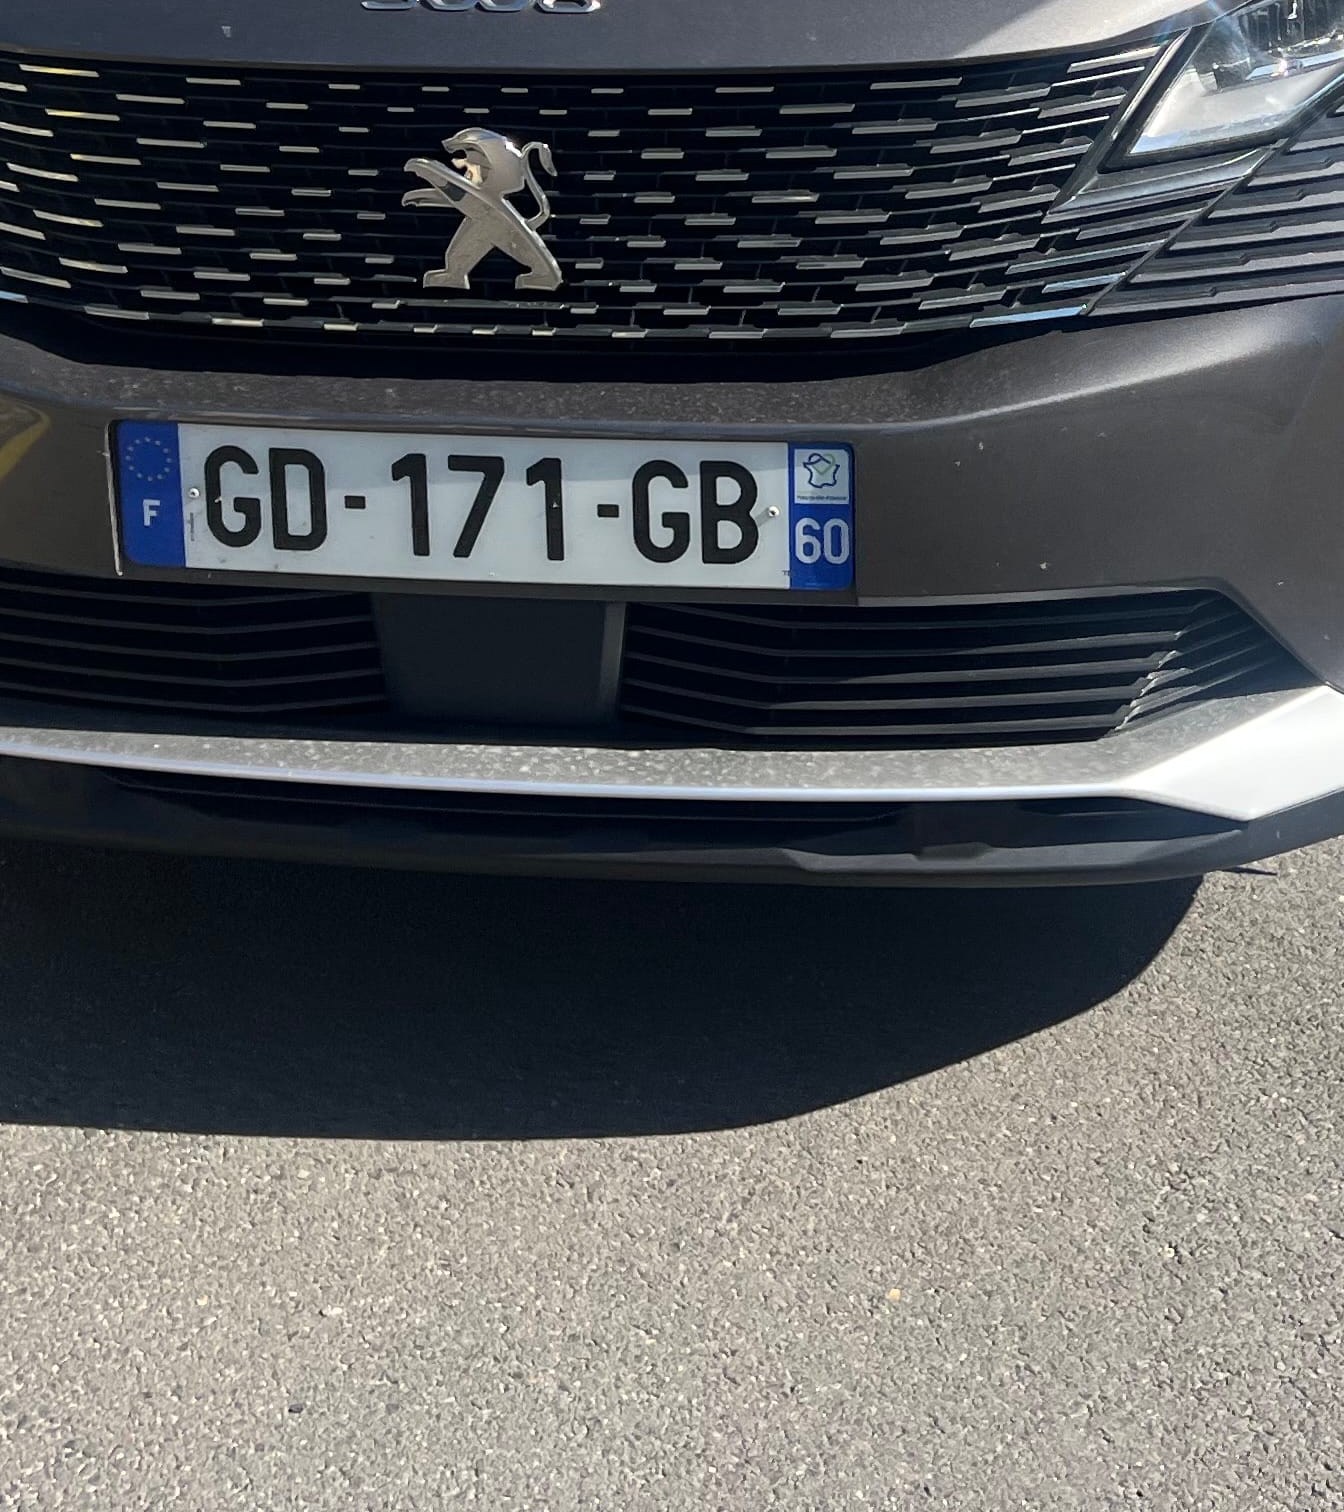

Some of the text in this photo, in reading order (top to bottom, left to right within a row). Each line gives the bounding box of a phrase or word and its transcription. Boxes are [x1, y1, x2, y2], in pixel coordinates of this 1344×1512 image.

[142, 498, 161, 527] F
[203, 444, 759, 564] GD-171-GB
[794, 517, 850, 565] 60
